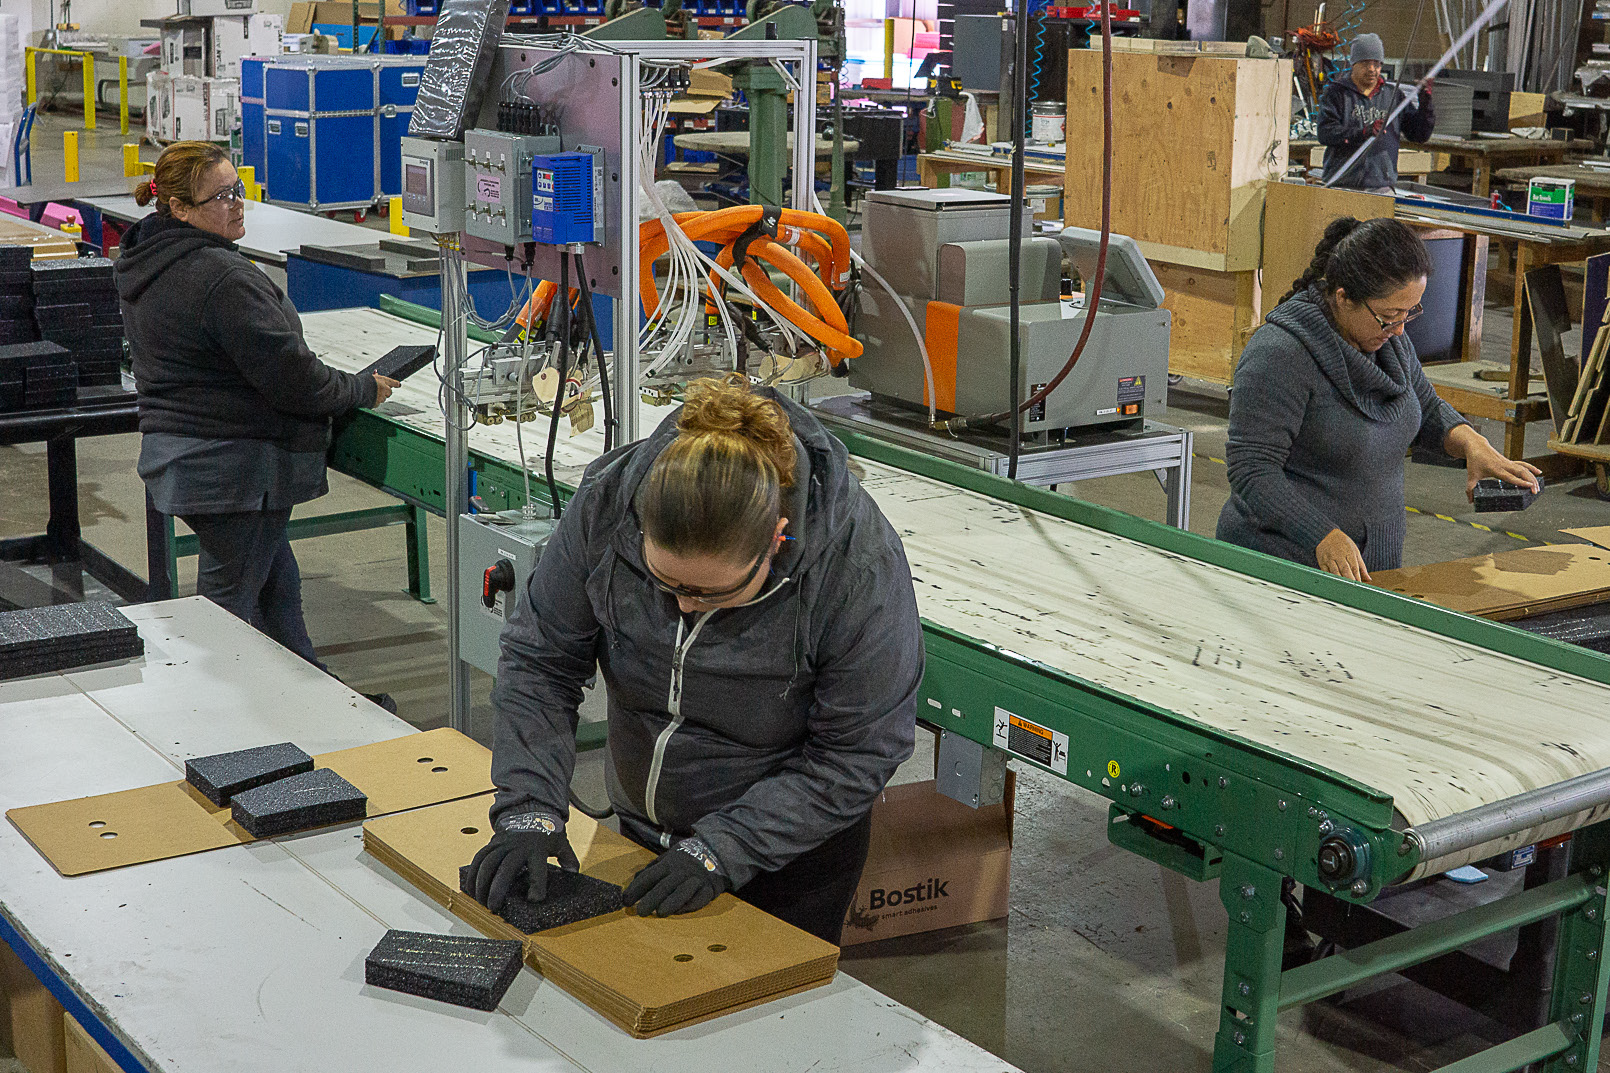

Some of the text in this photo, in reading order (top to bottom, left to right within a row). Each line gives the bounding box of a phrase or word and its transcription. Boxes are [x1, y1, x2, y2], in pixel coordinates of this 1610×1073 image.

[1023, 719, 1044, 736] WARNING
[870, 878, 950, 911] Bostik
[881, 905, 938, 920] smart adhesives
